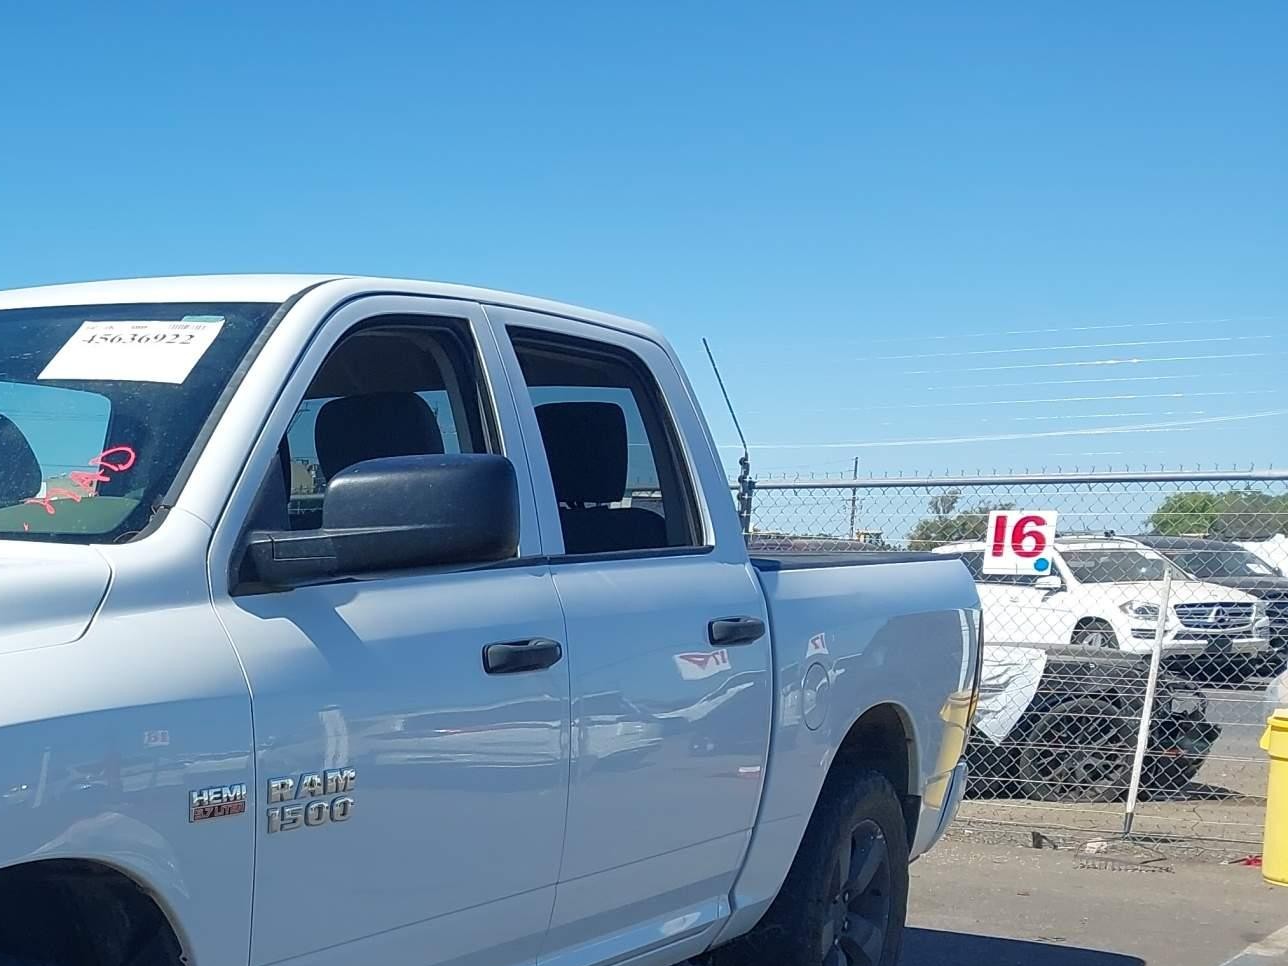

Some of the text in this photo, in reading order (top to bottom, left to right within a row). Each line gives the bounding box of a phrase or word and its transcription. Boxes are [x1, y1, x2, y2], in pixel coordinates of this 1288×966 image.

[82, 333, 195, 345] 45636922
[992, 515, 1048, 558] 16
[190, 783, 247, 807] HEMI
[267, 766, 356, 804] RAM
[267, 797, 354, 834] 1500
